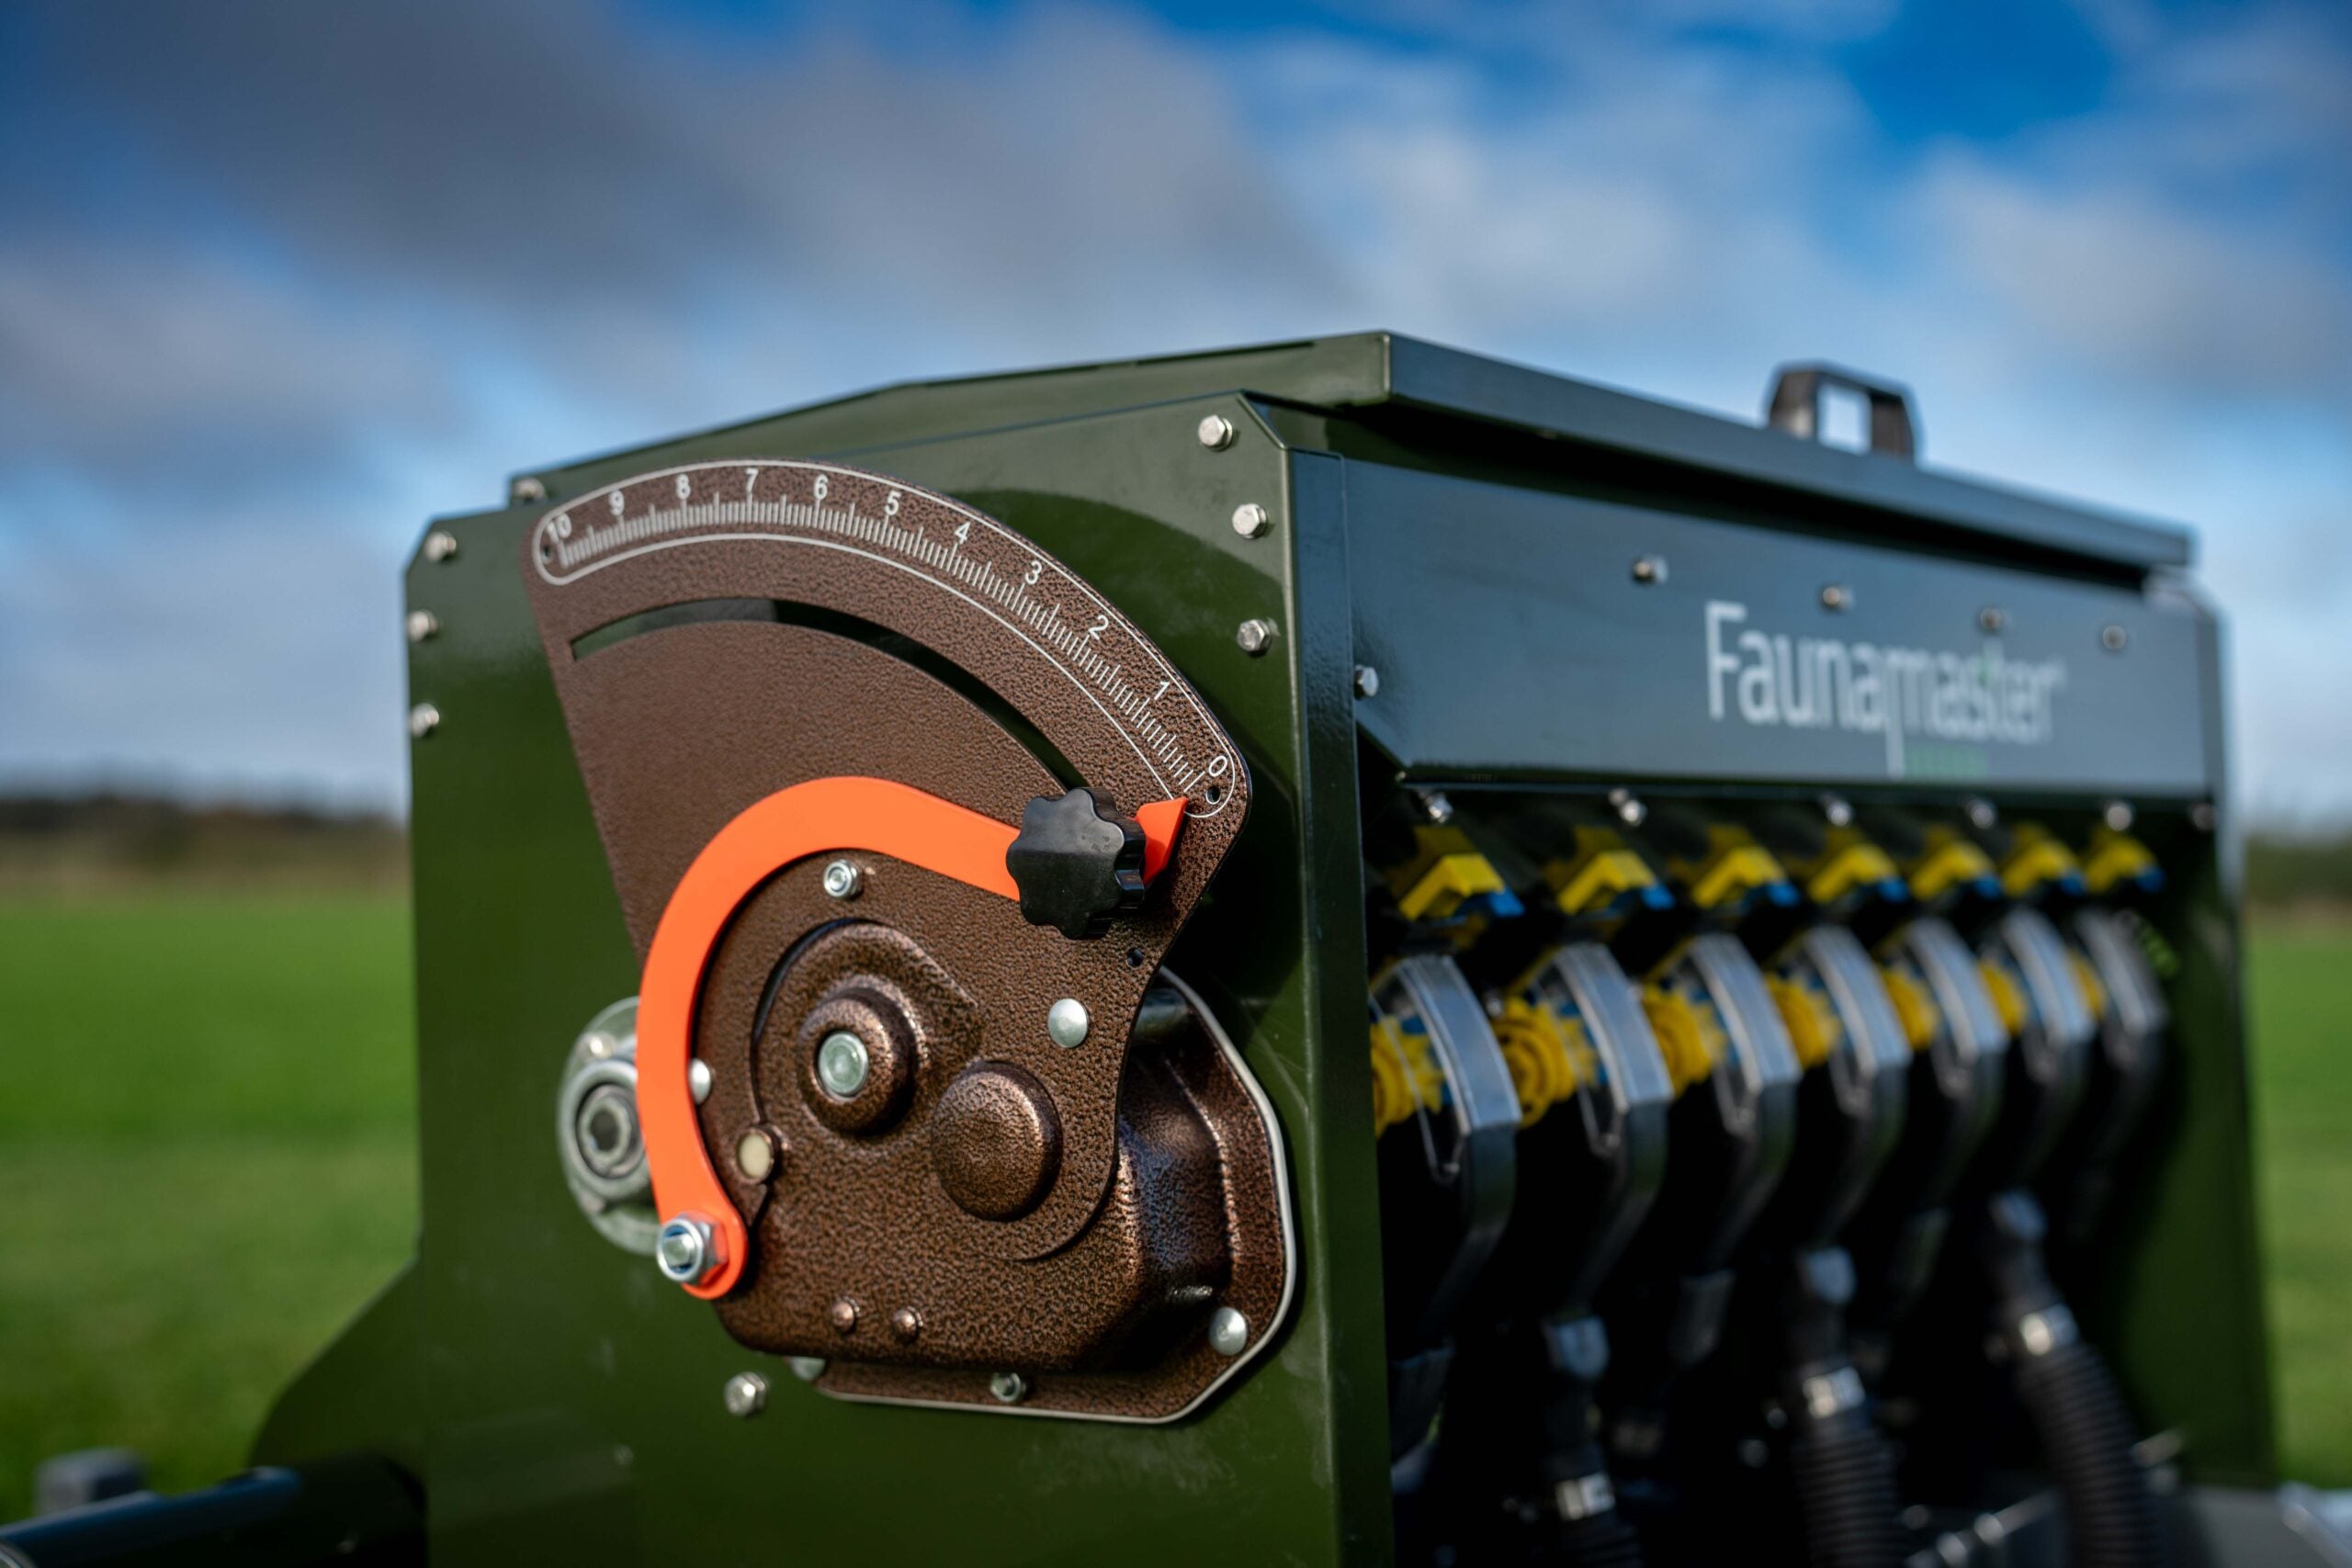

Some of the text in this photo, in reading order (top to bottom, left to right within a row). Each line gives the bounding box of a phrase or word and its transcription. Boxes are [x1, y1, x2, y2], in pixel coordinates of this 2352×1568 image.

[608, 491, 625, 516] 9
[675, 474, 691, 499] 8
[744, 468, 759, 493] 7
[813, 474, 828, 500] 6
[884, 491, 901, 515] 5
[955, 521, 971, 543] 4
[1024, 559, 1043, 586] 3
[1089, 615, 1110, 640] 2
[1154, 681, 1170, 701] 1
[1207, 754, 1227, 778] 0
[1705, 600, 2065, 781] Faunamaster
